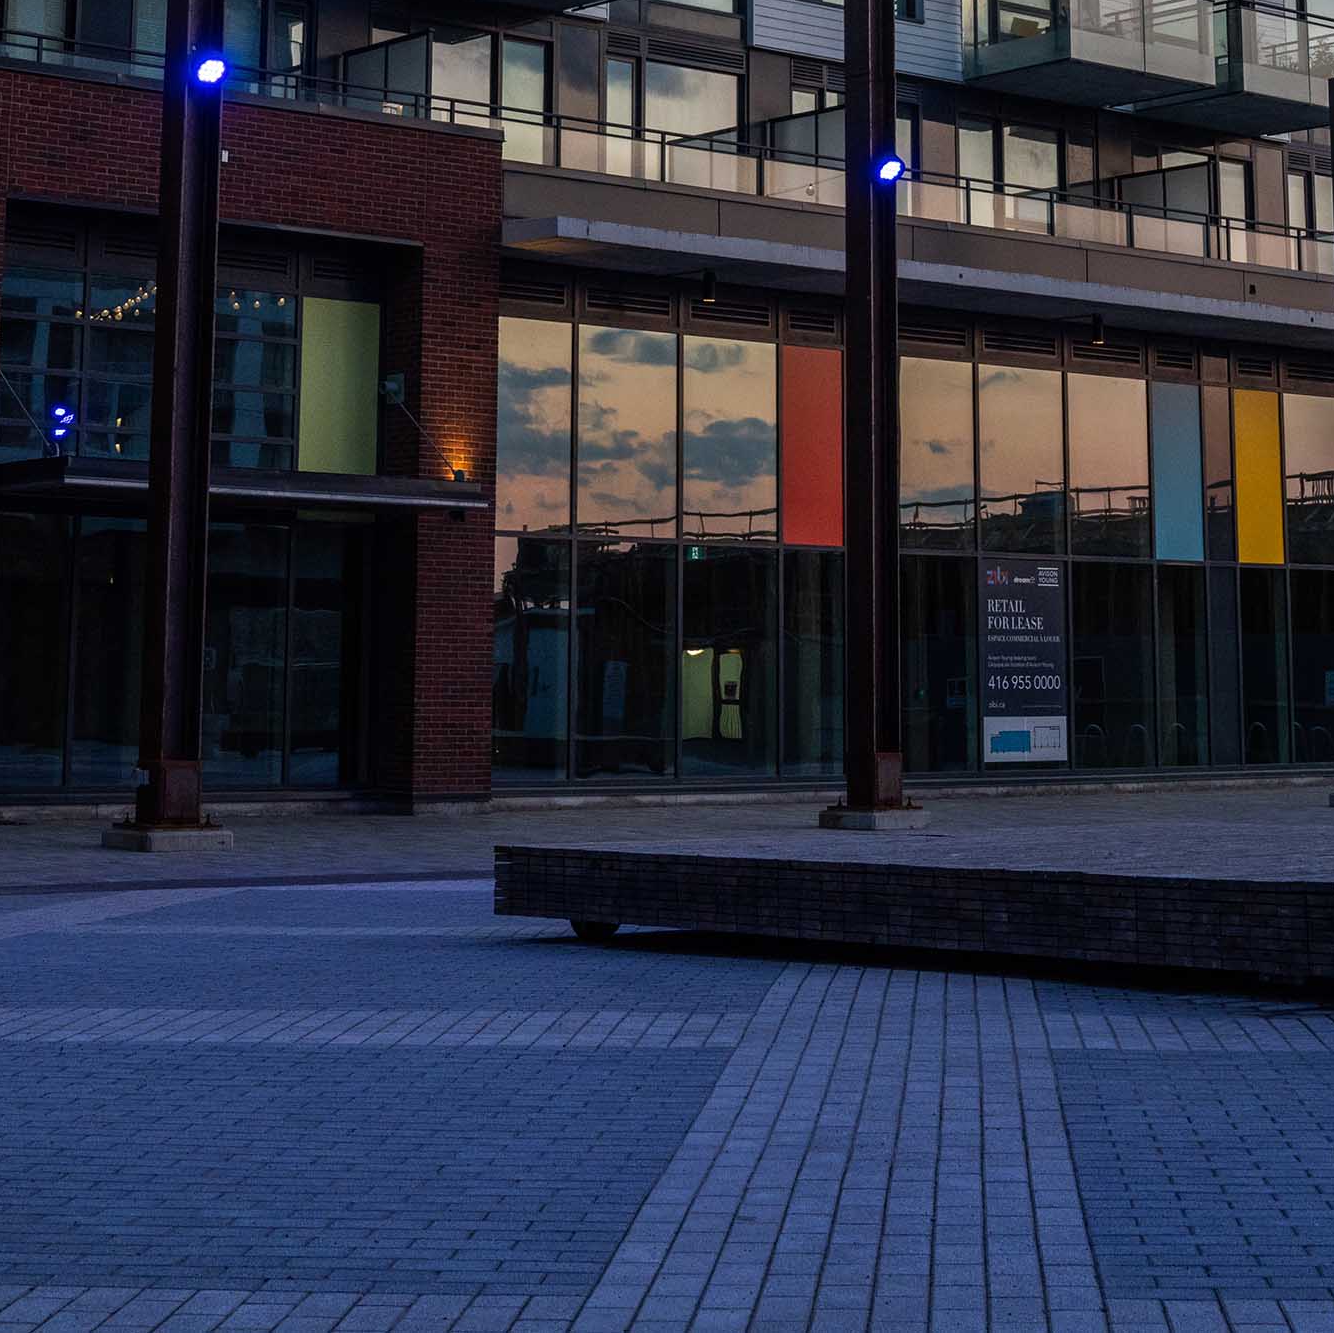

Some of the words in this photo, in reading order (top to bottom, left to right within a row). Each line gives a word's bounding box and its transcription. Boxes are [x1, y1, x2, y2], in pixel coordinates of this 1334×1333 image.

[987, 599, 1025, 613] RETAIL
[987, 616, 1009, 630] FOR
[1010, 616, 1043, 630] LEASE
[988, 675, 1009, 690] 416
[1011, 675, 1031, 689] 955
[1033, 675, 1061, 689] 0000
